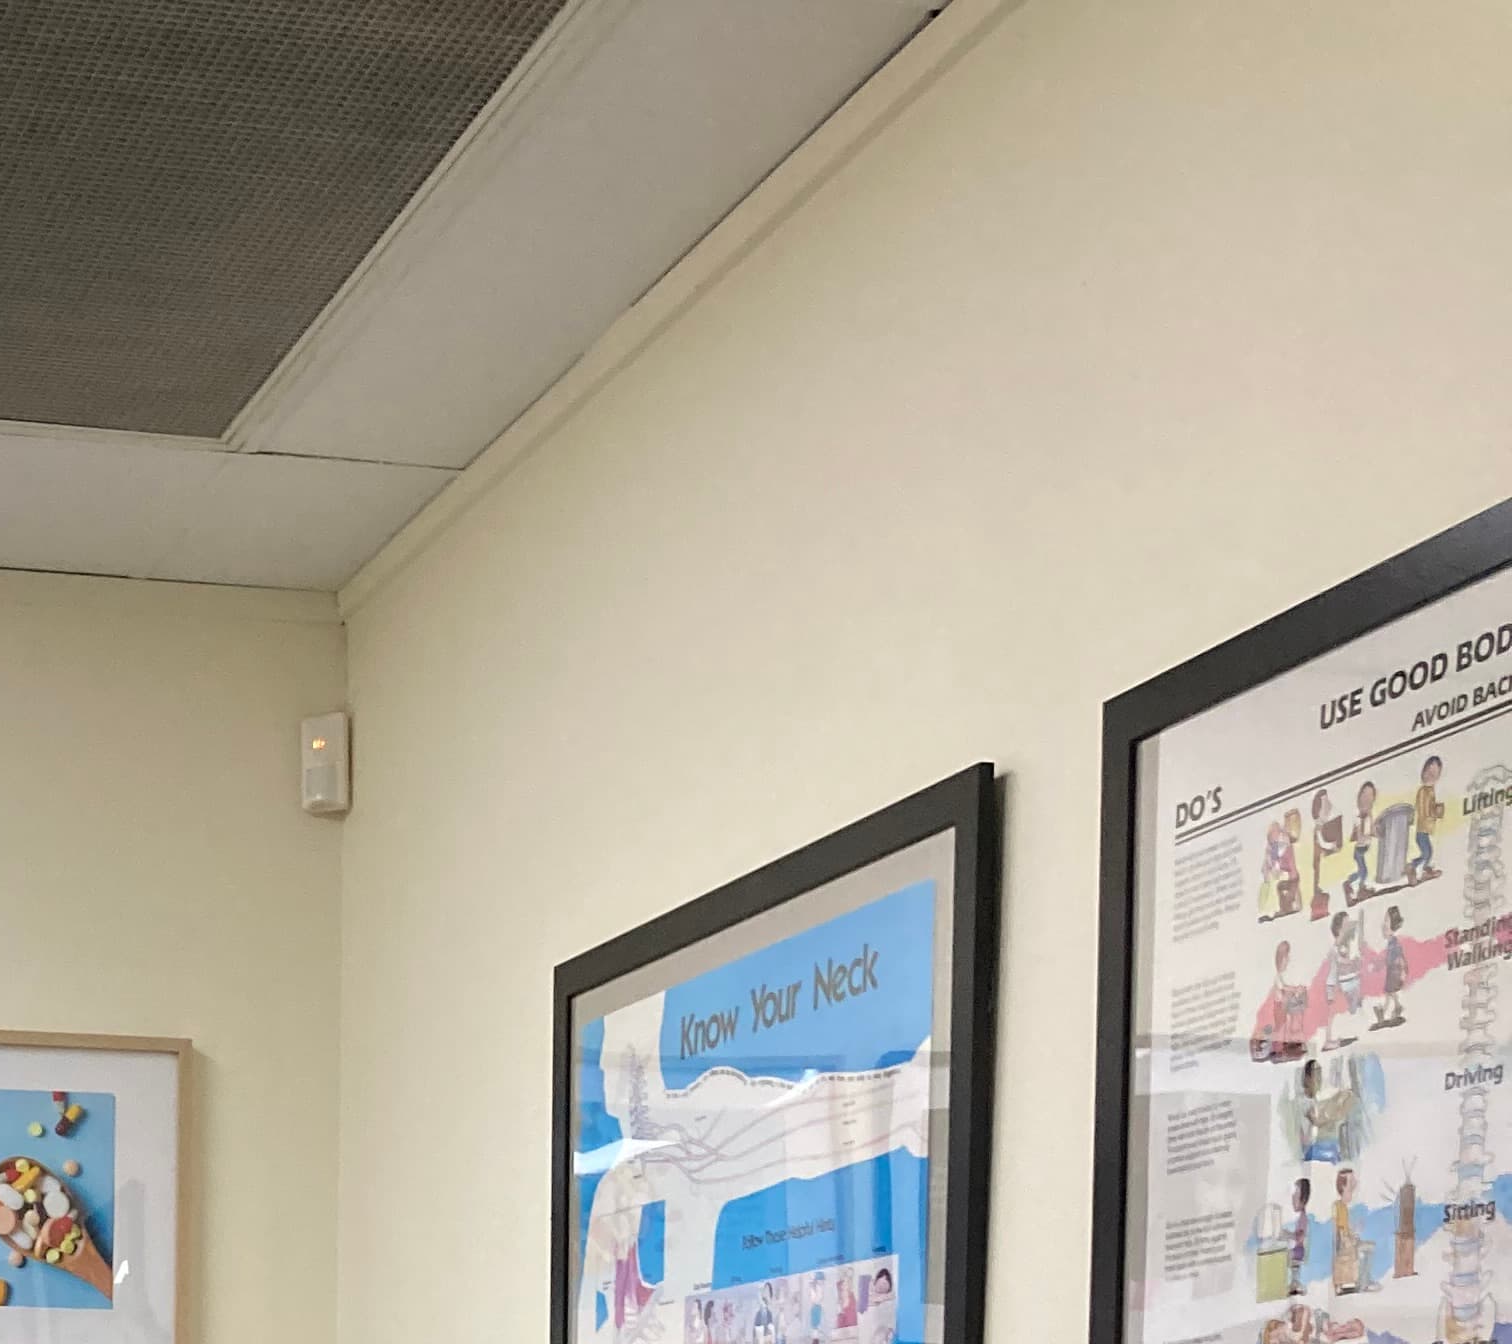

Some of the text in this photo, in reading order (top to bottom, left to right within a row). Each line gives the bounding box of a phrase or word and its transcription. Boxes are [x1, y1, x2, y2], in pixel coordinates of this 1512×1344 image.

[1320, 687, 1364, 729] USE
[1370, 653, 1448, 707] GOOD
[1412, 694, 1468, 731] AVOID
[1176, 785, 1223, 829] DO'S
[680, 943, 879, 1060] Know Your Neck
[1444, 1064, 1504, 1090] Driving
[1443, 1200, 1496, 1223] Sitting
